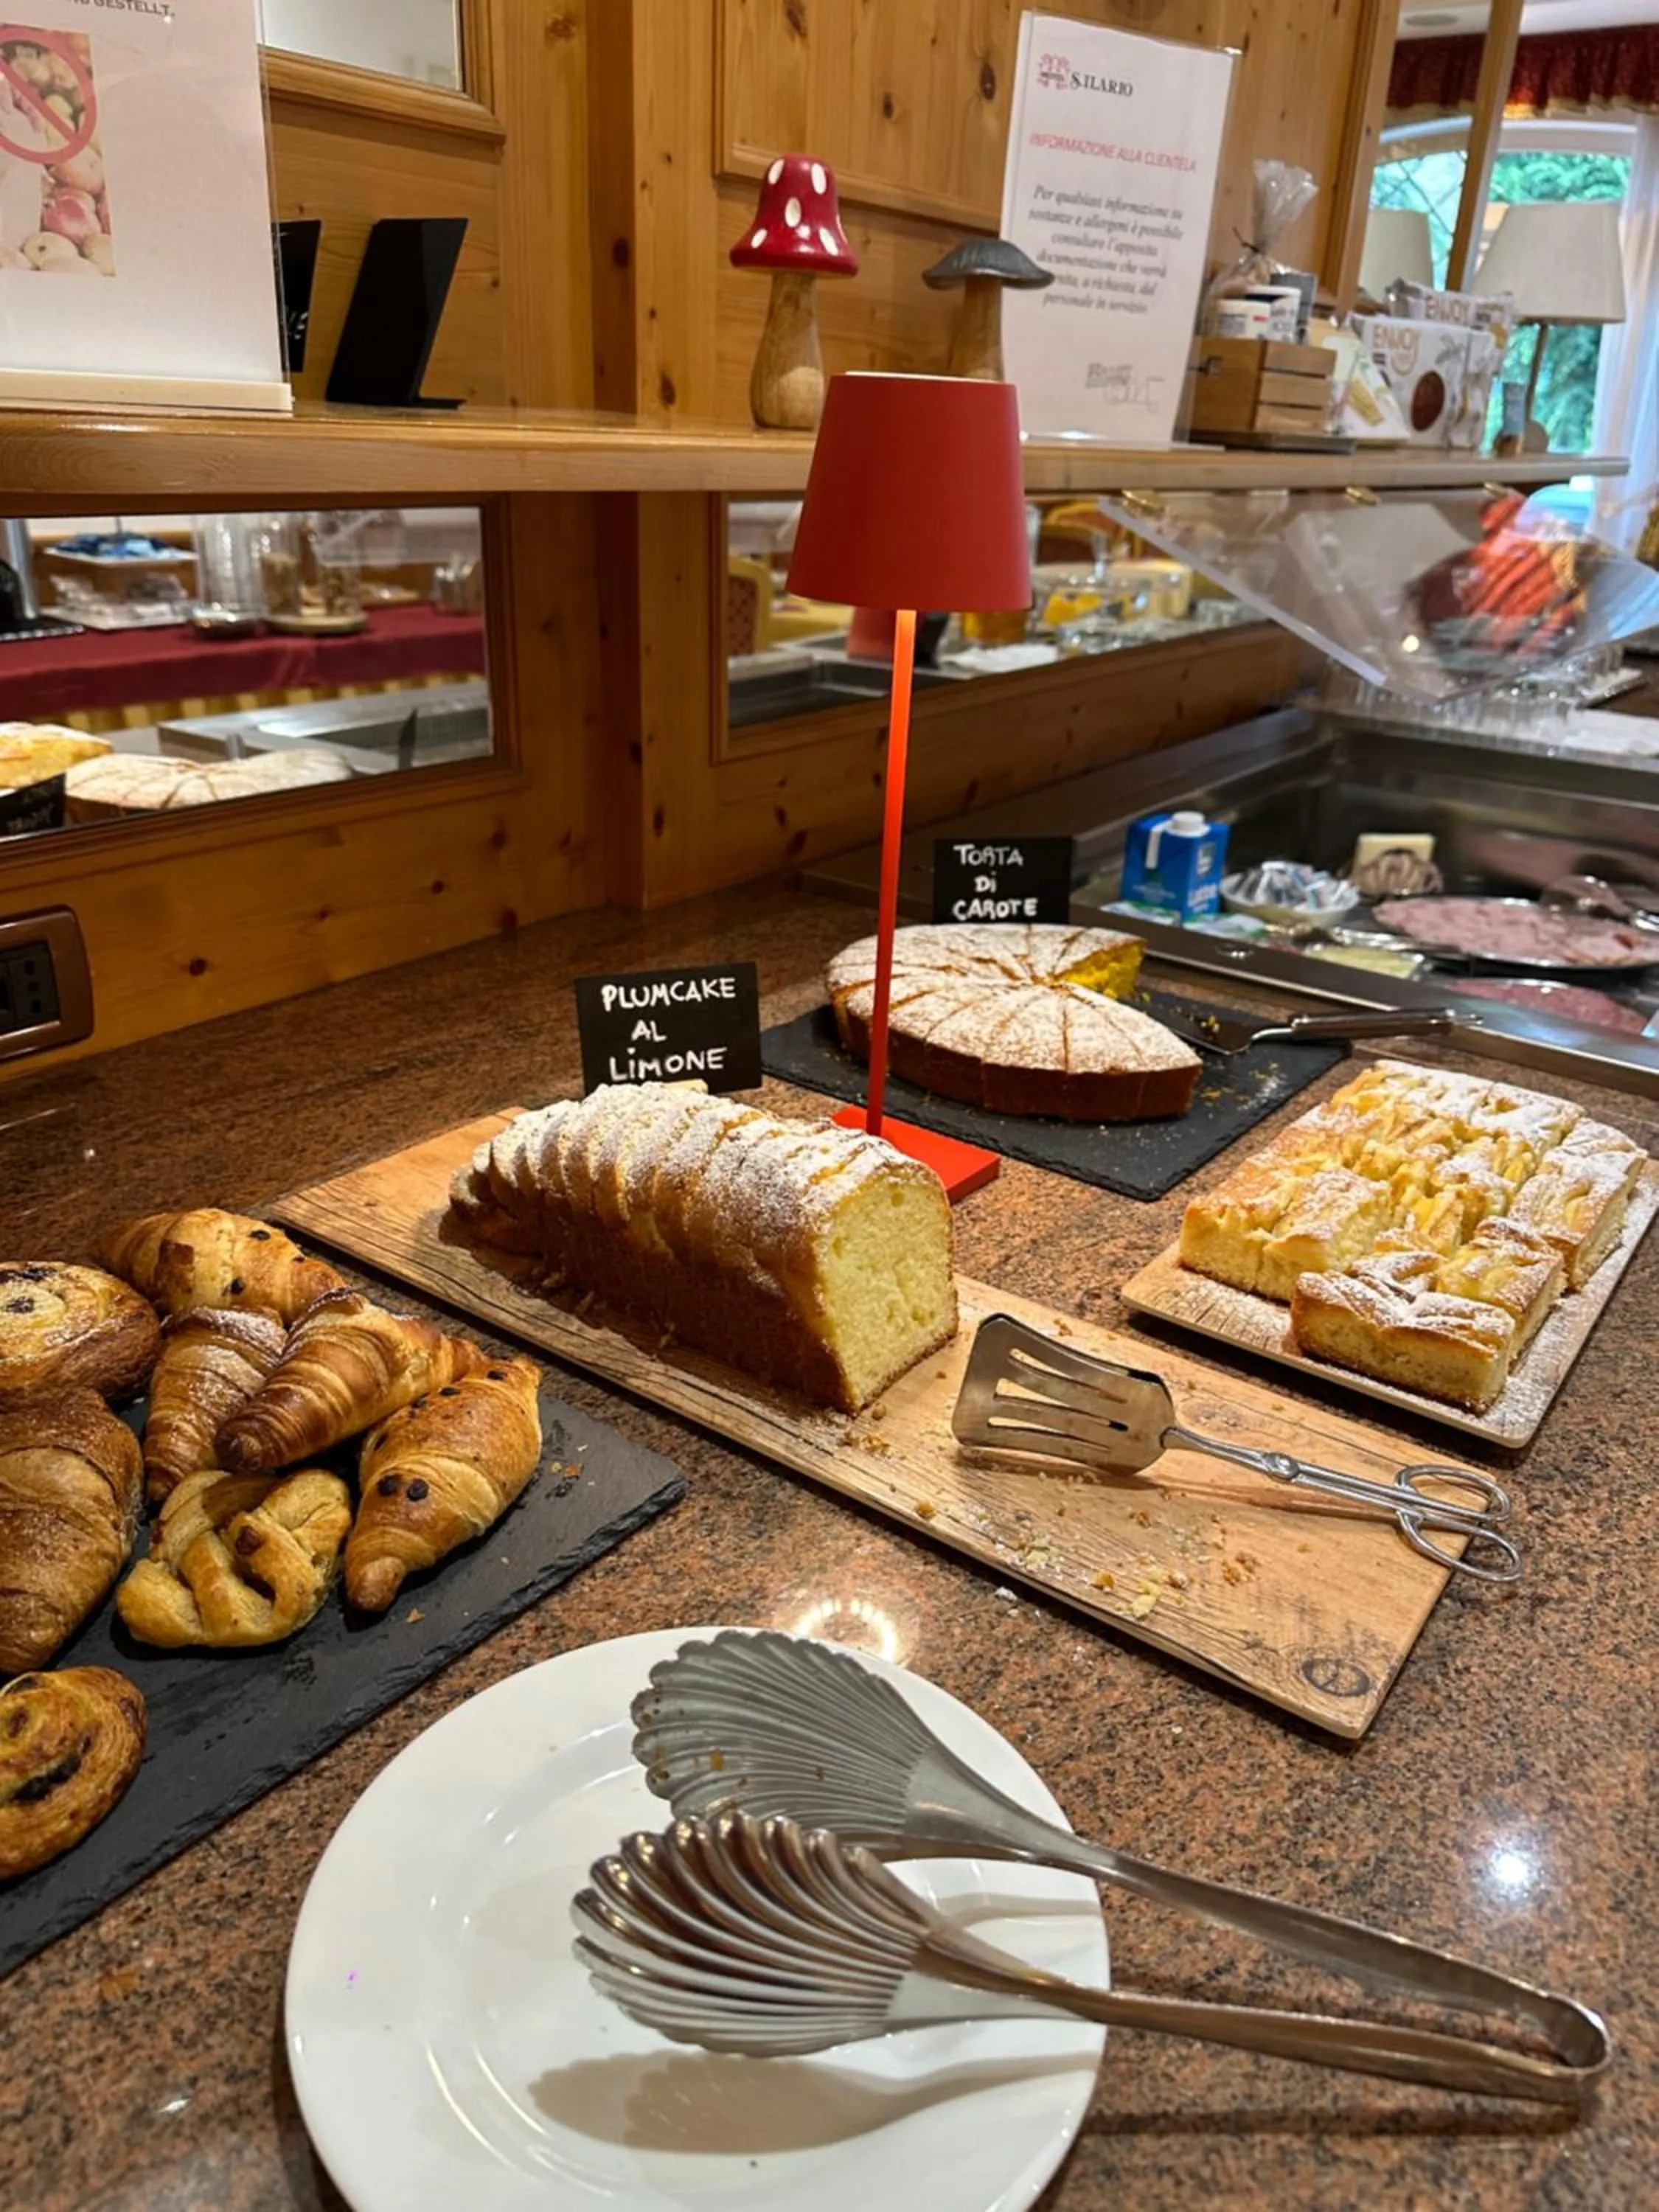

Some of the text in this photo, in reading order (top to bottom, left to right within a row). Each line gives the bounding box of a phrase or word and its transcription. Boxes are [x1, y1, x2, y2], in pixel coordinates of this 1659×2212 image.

[1029, 131, 1197, 172] INFORMAZIONE ALLA CLIENTELA
[1034, 184, 1054, 200] Per
[1105, 195, 1169, 218] informazione
[1084, 214, 1129, 234] allergeni
[1138, 224, 1183, 240] possibile
[1051, 233, 1105, 250] consultare
[1037, 248, 1118, 271] documentazione
[1043, 293, 1093, 308] personale
[953, 844, 1024, 866] TORTA
[952, 897, 1038, 921] CAROTE
[601, 977, 736, 1012] PLUMCAKE
[631, 1019, 667, 1042] AL
